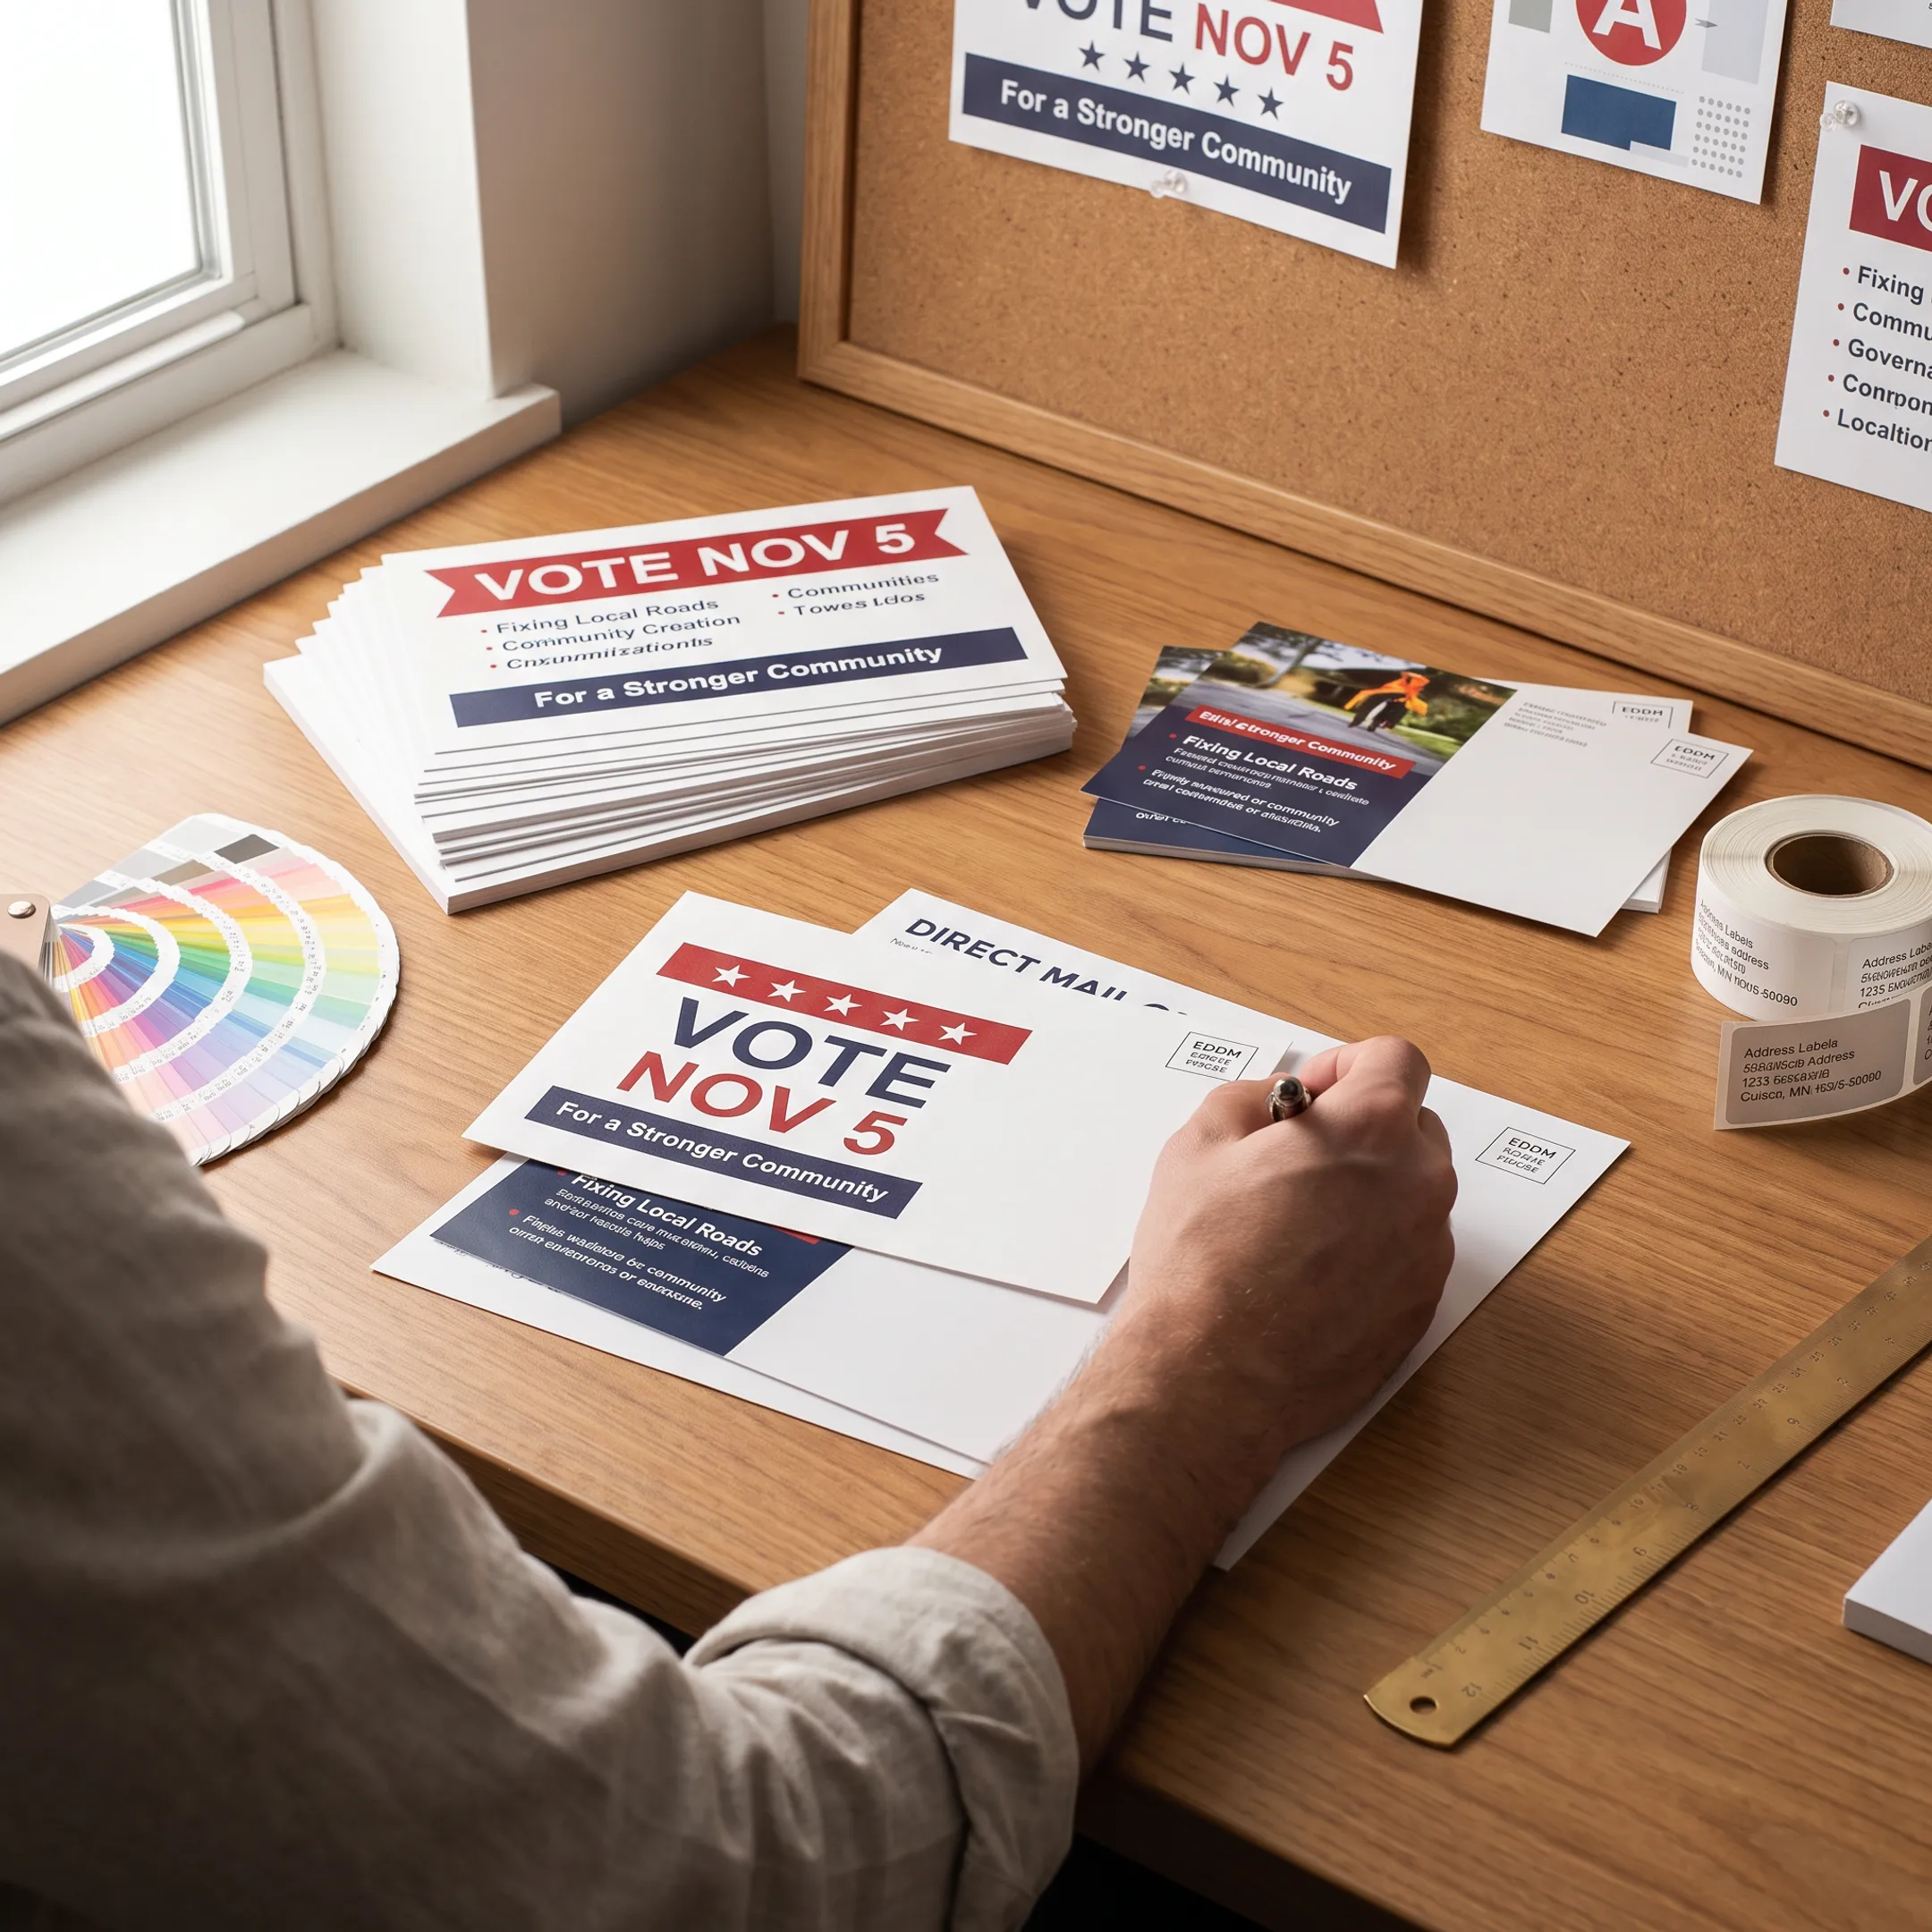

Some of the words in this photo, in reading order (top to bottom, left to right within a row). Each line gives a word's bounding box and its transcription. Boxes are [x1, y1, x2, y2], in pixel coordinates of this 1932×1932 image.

[1592, 0, 1662, 50] A
[1024, 0, 1173, 43] TE
[1195, 3, 1310, 76] NOV
[1326, 41, 1353, 90] 5
[1000, 79, 1047, 113] For
[1053, 96, 1069, 120] a
[1077, 97, 1196, 150] Stronger
[1200, 131, 1352, 205] Community
[1857, 265, 1924, 306] Fixing
[474, 551, 679, 601] VOTE
[697, 530, 850, 577] NOV
[875, 523, 916, 555] 5
[787, 574, 939, 598] Communities
[496, 617, 568, 633] Fixing
[576, 608, 638, 625] Local
[646, 599, 719, 617] Roads
[502, 627, 635, 652] Community
[642, 614, 741, 635] Creation
[534, 688, 587, 708] For
[597, 686, 615, 701] a
[623, 668, 759, 699] Stronger
[767, 646, 944, 680] Community
[1182, 735, 1242, 760] Fixing
[1243, 752, 1297, 774] Local
[1297, 767, 1359, 790] Roads
[1308, 741, 1397, 771] Community
[1267, 803, 1341, 827] community
[905, 918, 1042, 973] DIRECT
[1724, 924, 1753, 949] Labels
[1861, 952, 1907, 969] Address
[674, 996, 952, 1109] VOTE
[1192, 1041, 1242, 1058] EDDM
[1744, 1045, 1795, 1059] Address
[1807, 1050, 1855, 1066] Address
[615, 1051, 837, 1135] NOV
[843, 1110, 908, 1157] 5
[555, 1100, 602, 1124] For
[604, 1116, 622, 1131] a
[626, 1121, 738, 1162] Stronger
[741, 1153, 890, 1204] Community
[1508, 1137, 1557, 1159] EDDM
[571, 1174, 636, 1208] Fixing
[636, 1199, 696, 1231] Local
[694, 1221, 764, 1257] Roads
[647, 1266, 727, 1302] community
[1574, 1589, 1595, 1606] 10
[1461, 1682, 1482, 1698] 12
